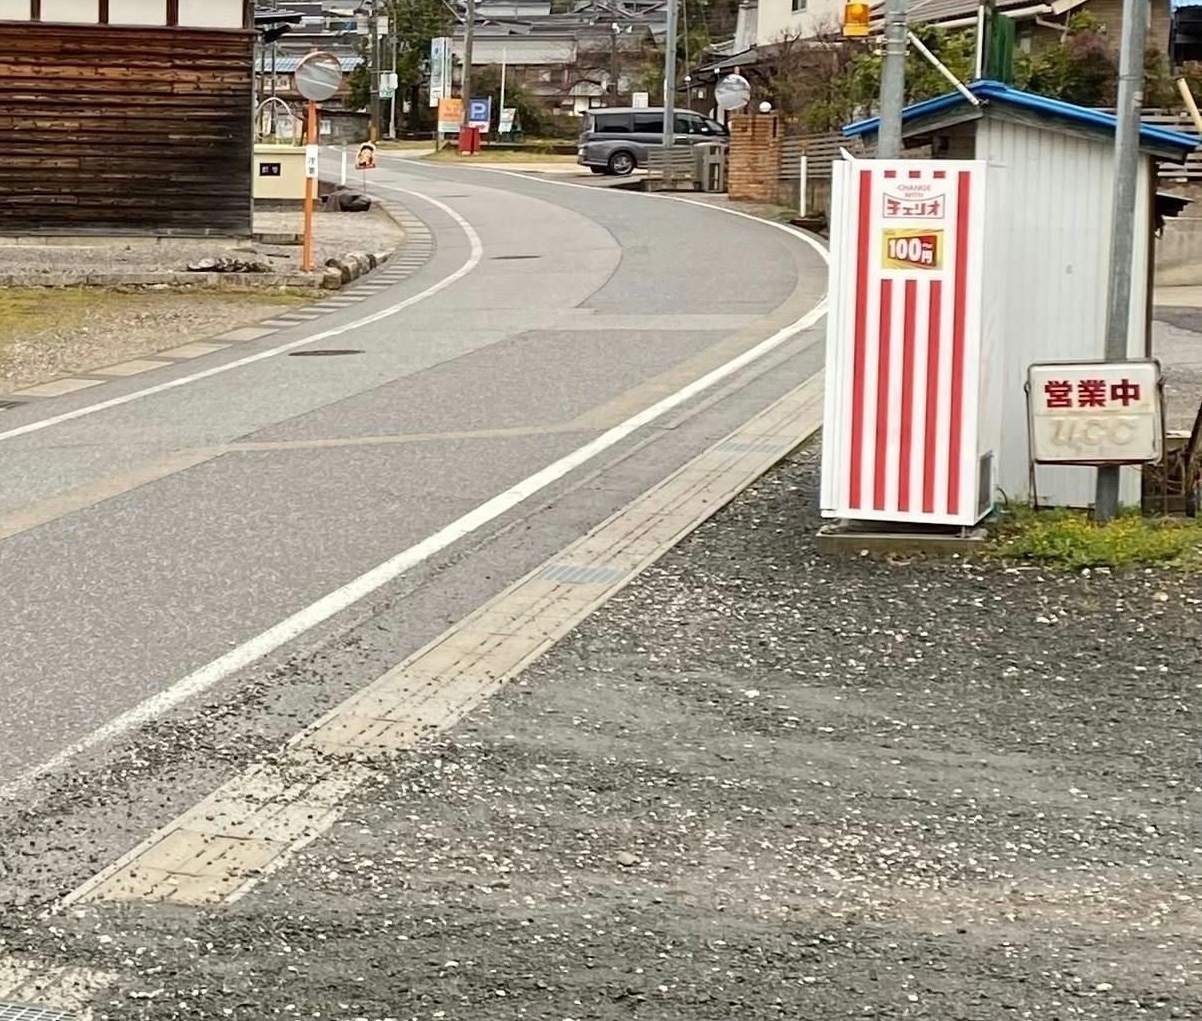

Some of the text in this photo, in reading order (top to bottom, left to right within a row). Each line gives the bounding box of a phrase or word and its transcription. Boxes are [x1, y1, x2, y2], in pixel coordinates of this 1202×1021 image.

[470, 101, 487, 121] P
[886, 198, 940, 216] チェリオ
[1044, 378, 1140, 408] 営業中
